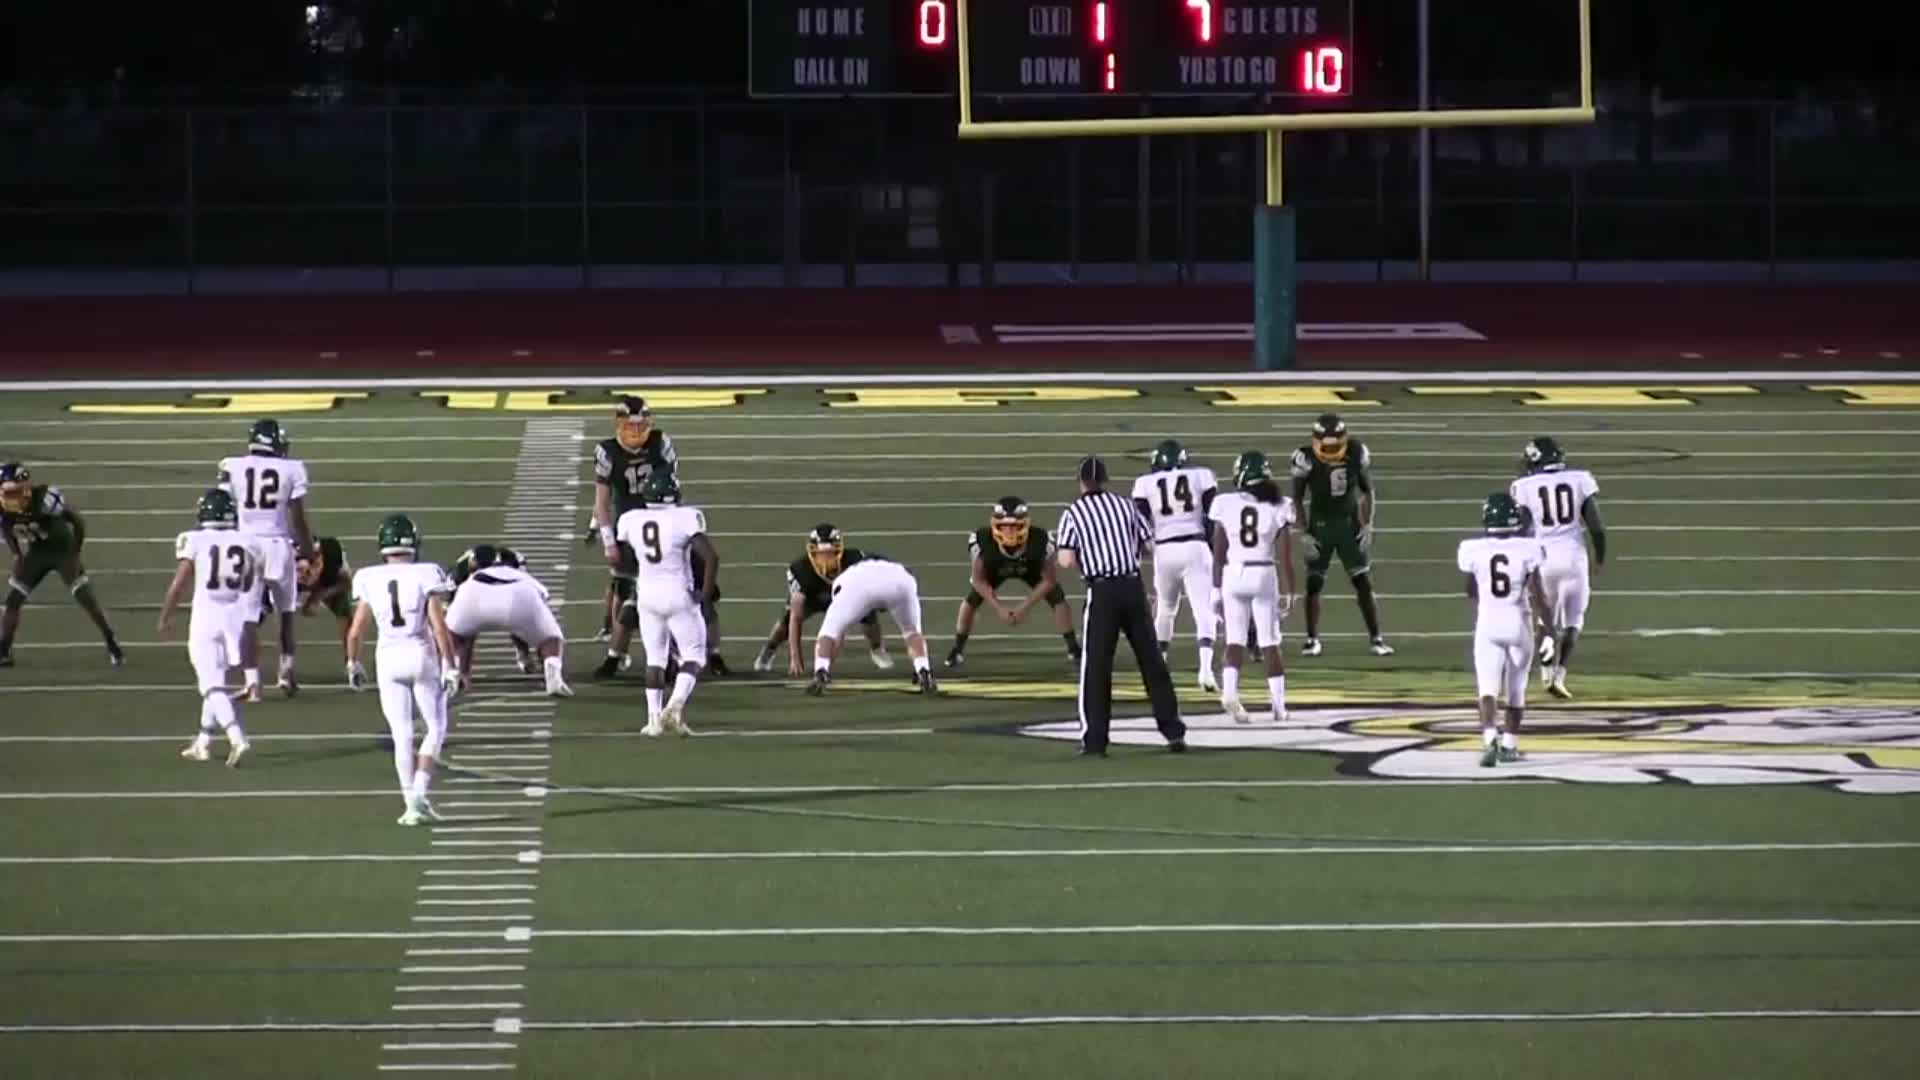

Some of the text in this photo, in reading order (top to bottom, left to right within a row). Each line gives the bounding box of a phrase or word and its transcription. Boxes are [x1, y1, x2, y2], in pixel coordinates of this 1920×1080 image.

[797, 7, 865, 36] HOME
[919, 0, 946, 45] 0
[1094, 0, 1108, 42] 1
[1184, 0, 1211, 43] 7
[1223, 7, 1318, 35] GUESTS
[793, 57, 869, 86] BALL ON
[1020, 57, 1081, 86] DOWN
[1106, 52, 1117, 92] 1
[1178, 55, 1277, 85] YDS TO GO
[1302, 48, 1344, 93] 10
[244, 467, 280, 509] 12
[1157, 475, 1194, 516] 14
[1538, 483, 1574, 527] 10
[641, 520, 662, 564] 9
[1240, 506, 1258, 548] 8
[206, 544, 247, 590] 13
[1490, 553, 1511, 598] 6
[387, 579, 406, 627] 1
